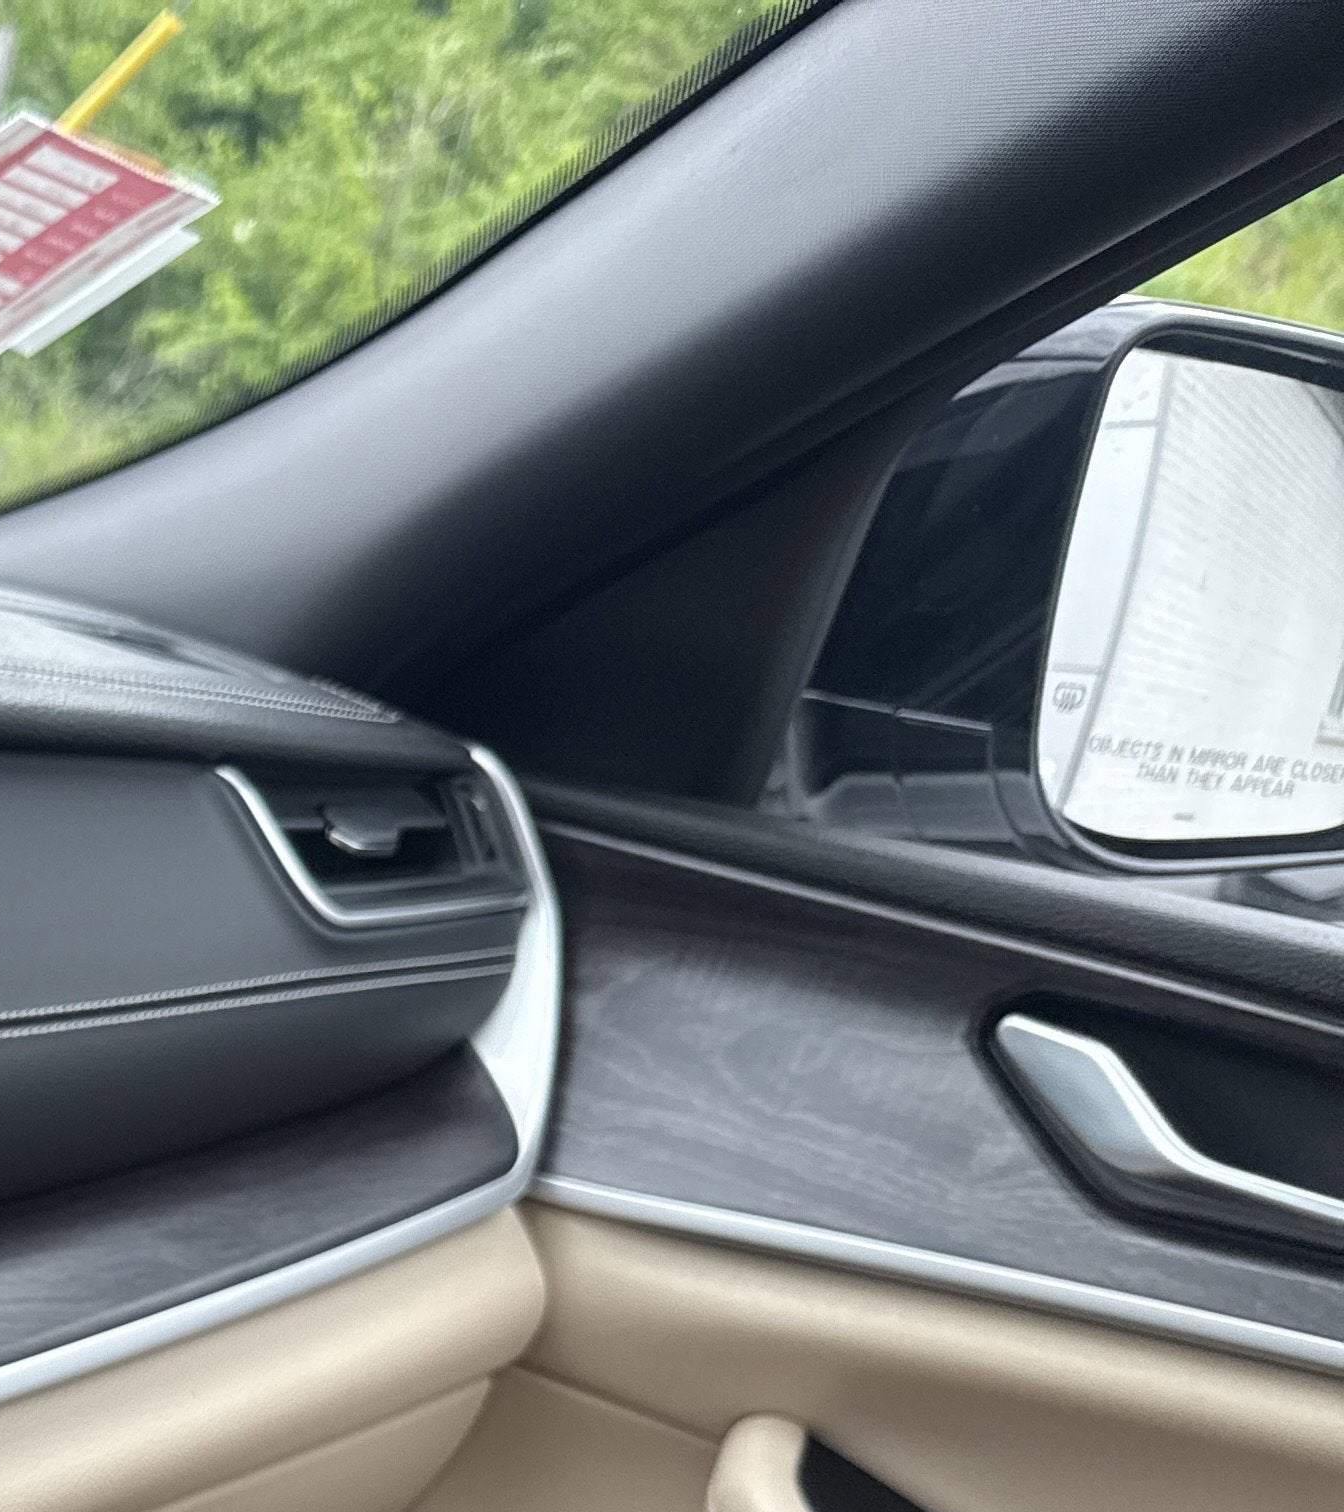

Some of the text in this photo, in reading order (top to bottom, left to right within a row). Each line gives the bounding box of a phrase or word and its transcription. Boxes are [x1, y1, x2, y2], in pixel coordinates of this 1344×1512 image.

[1136, 762, 1296, 798] THAN THEY APPEAR
[1252, 755, 1288, 777] ARE
